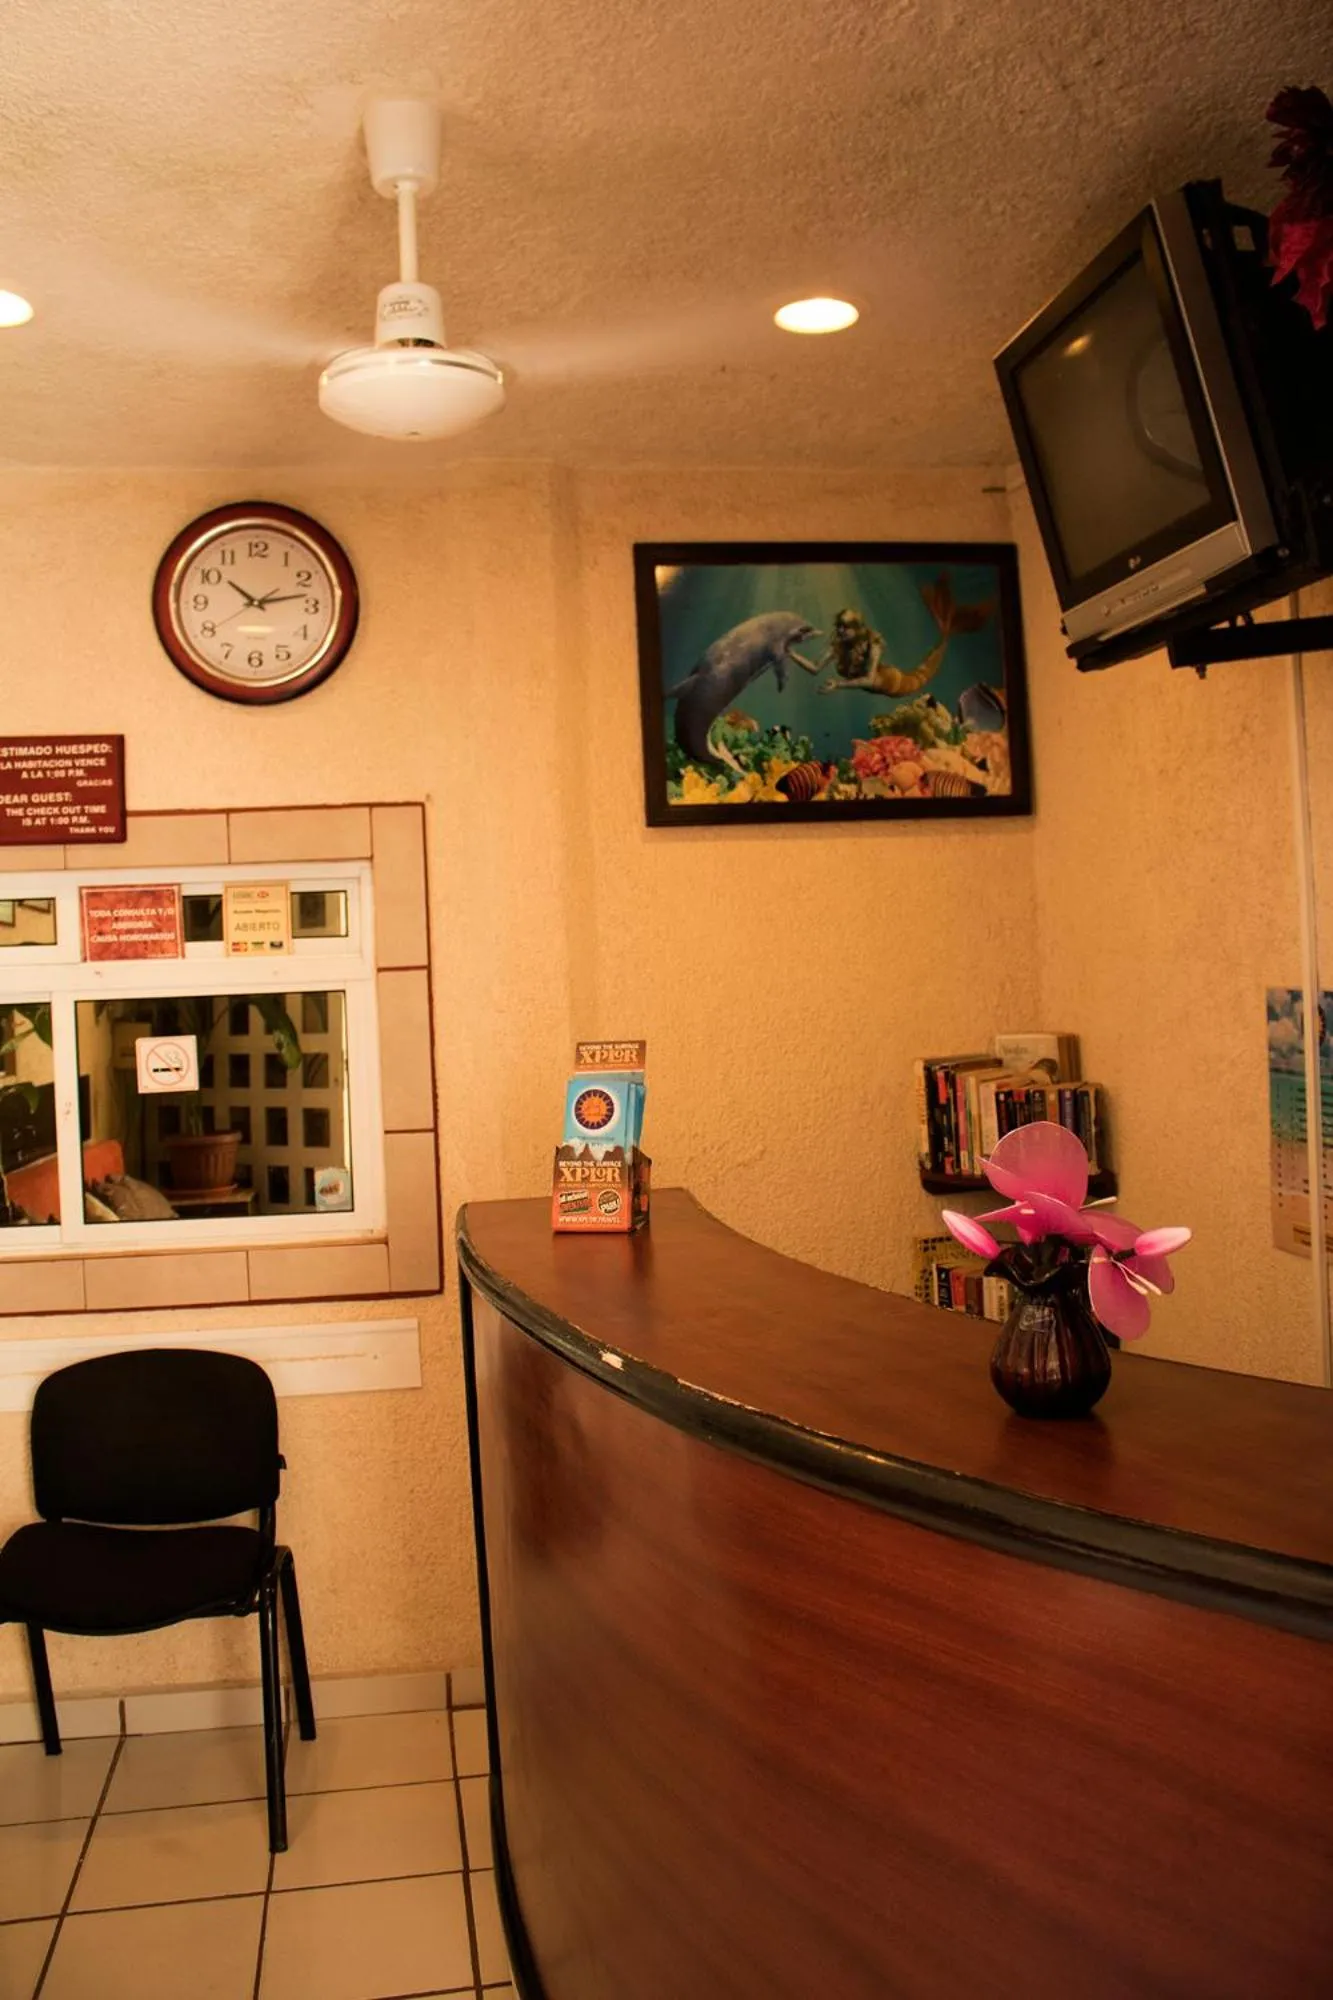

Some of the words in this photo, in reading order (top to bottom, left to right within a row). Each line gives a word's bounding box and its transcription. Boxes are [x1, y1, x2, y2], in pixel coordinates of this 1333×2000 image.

[220, 549, 236, 566] 11
[247, 541, 269, 558] 12
[282, 551, 290, 567] 1
[201, 567, 222, 586] 10
[295, 570, 313, 588] 2
[192, 593, 209, 612] 9
[304, 597, 320, 615] 3
[200, 620, 216, 639] 8
[292, 624, 308, 641] 4
[220, 642, 235, 660] 7
[247, 650, 264, 669] 6
[275, 644, 292, 662] 5
[0, 746, 52, 757] STIMADO
[0, 761, 12, 770] LA
[14, 759, 73, 769] HABITACION
[74, 757, 107, 767] VENCE
[21, 771, 29, 779] A
[30, 770, 44, 779] LA
[76, 779, 113, 787] GRACIAS
[5, 808, 25, 817] THE
[26, 806, 61, 816] CHECK
[61, 805, 82, 815] OUT
[83, 804, 107, 814] TIME
[22, 818, 33, 827] IS
[34, 817, 47, 826] AT
[234, 921, 280, 932] ABIERTO
[559, 1167, 621, 1182] XPLOR
